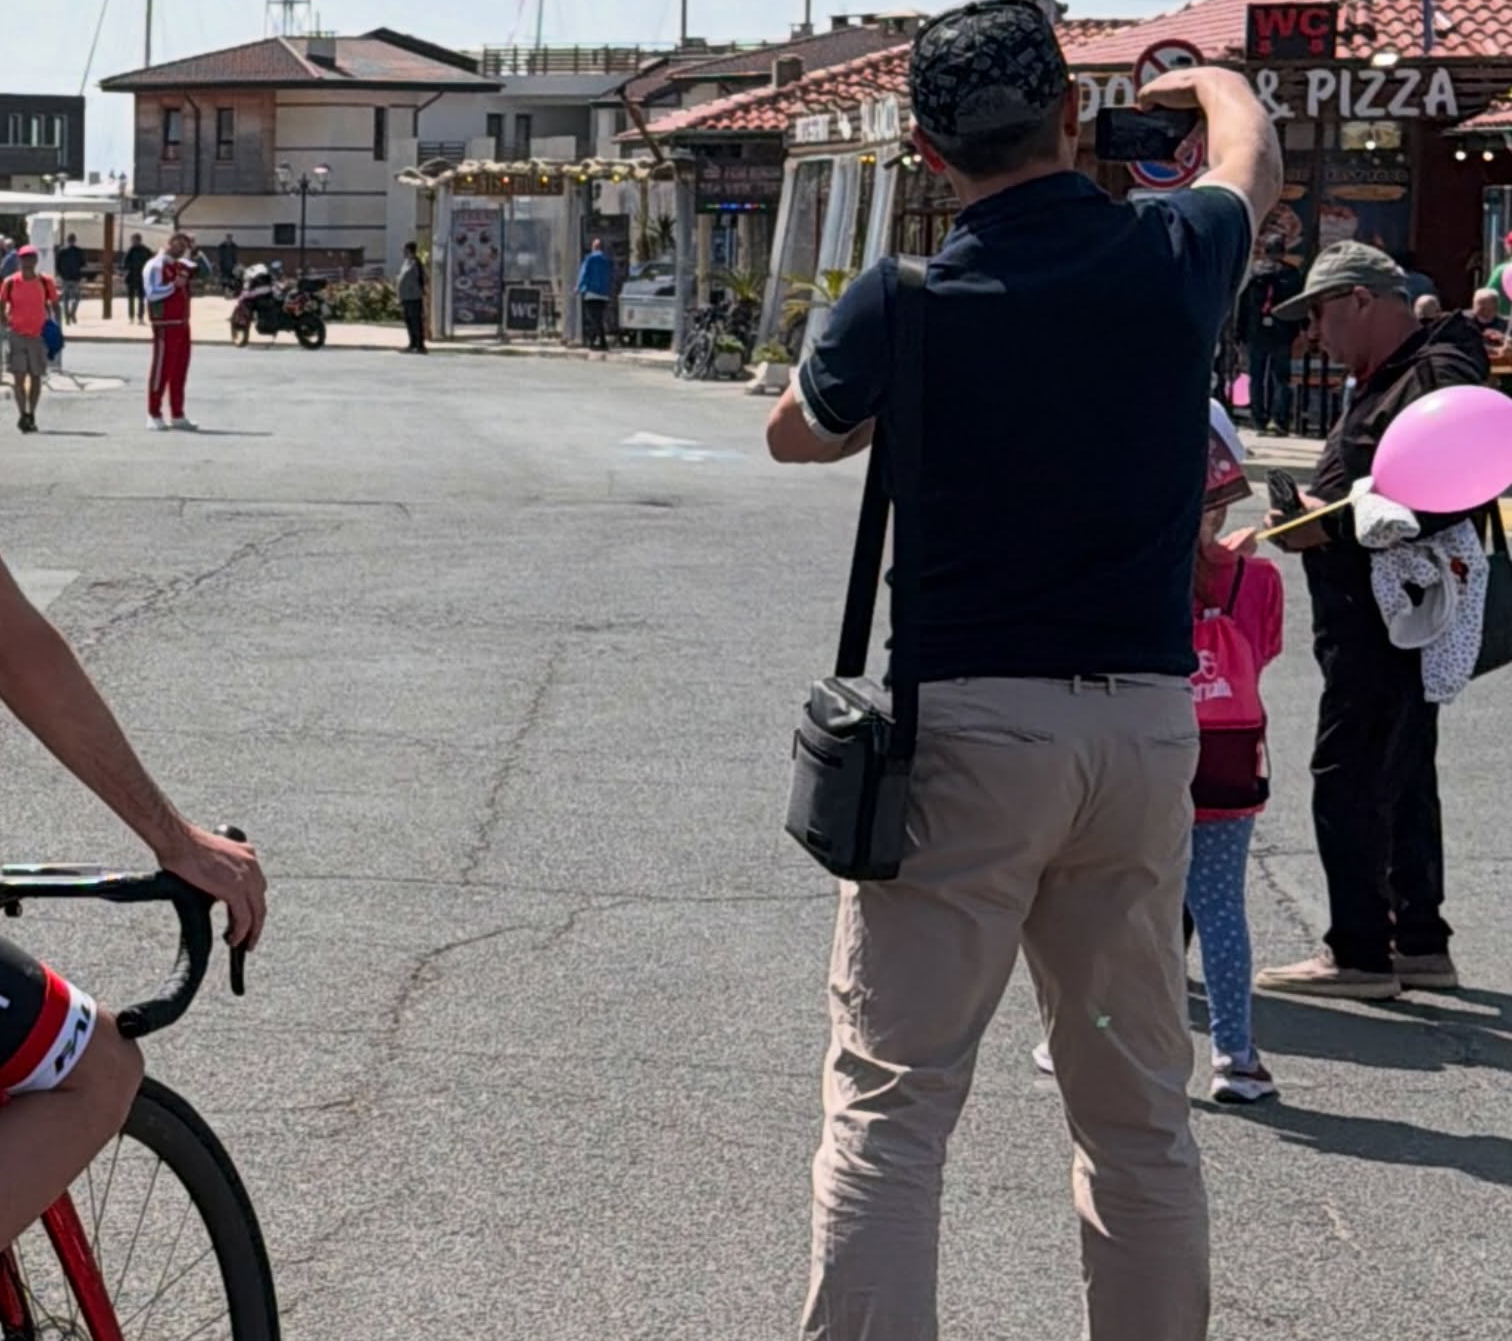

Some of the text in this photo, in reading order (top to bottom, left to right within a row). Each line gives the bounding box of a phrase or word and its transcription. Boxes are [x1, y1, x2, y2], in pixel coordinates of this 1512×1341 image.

[1254, 9, 1330, 38] WC
[1257, 67, 1458, 120] & PIZZA
[511, 302, 537, 319] WC
